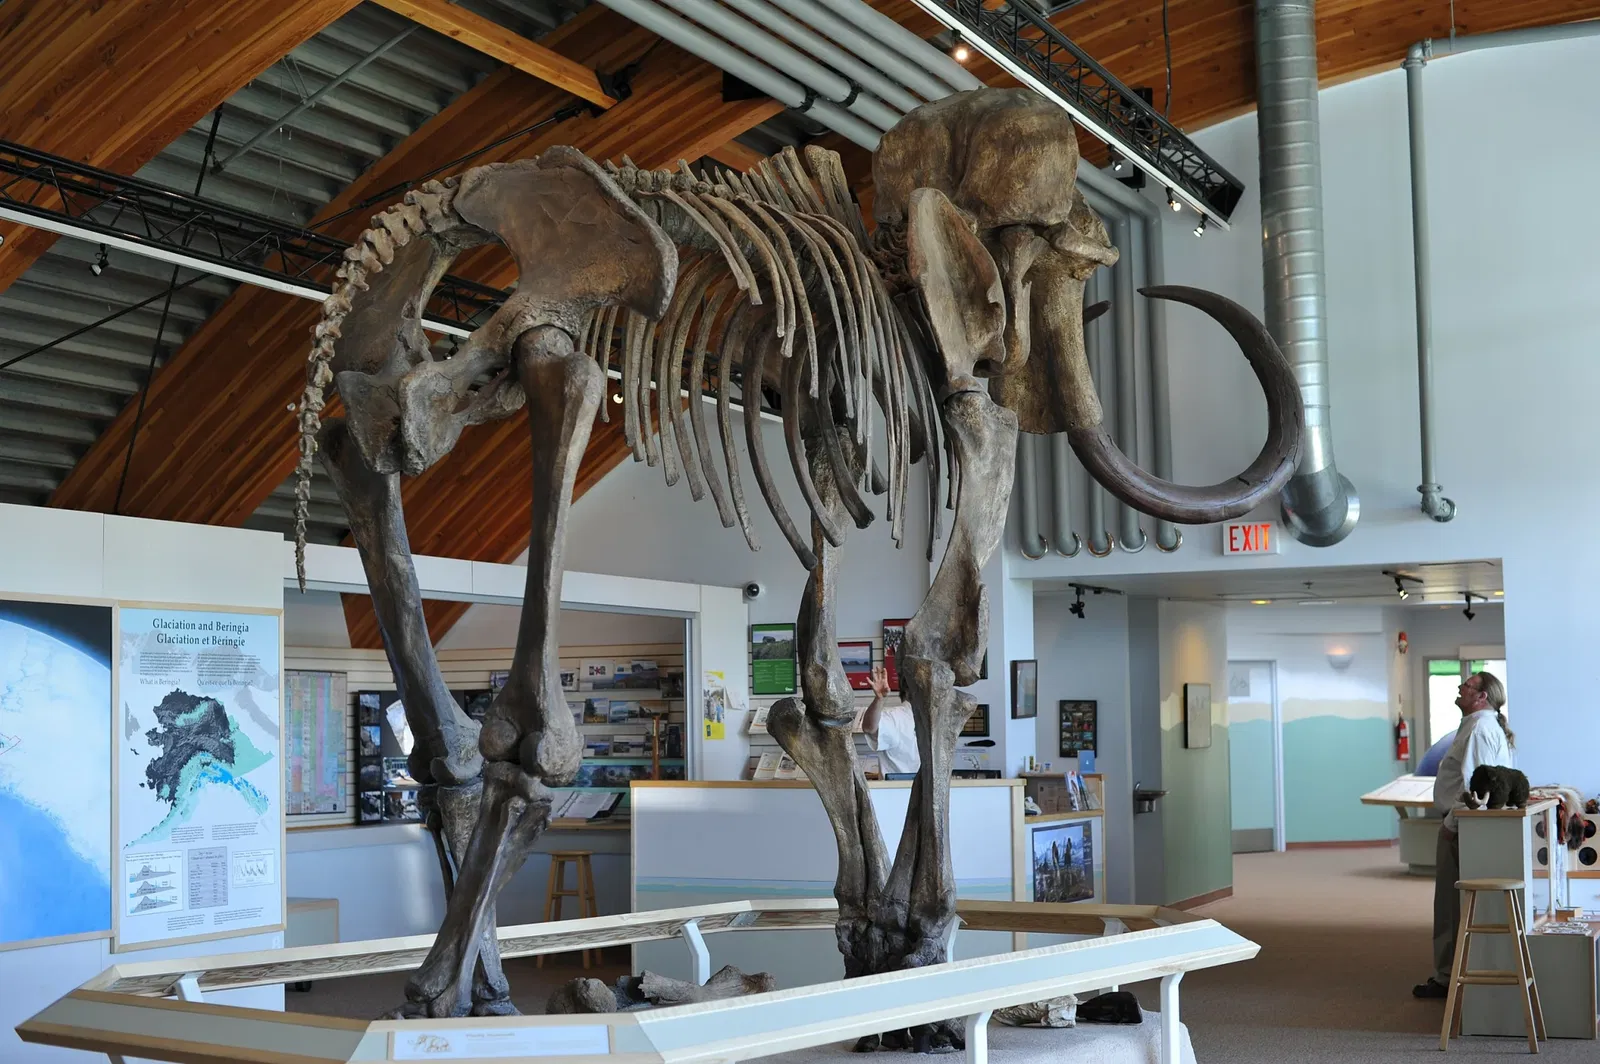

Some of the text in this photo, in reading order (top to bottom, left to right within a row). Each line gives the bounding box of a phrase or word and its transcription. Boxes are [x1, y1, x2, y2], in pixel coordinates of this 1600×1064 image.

[1229, 523, 1271, 552] EXIT
[152, 618, 249, 635] Glaciation and Beringia
[156, 633, 245, 649] Glaciation et Béringie
